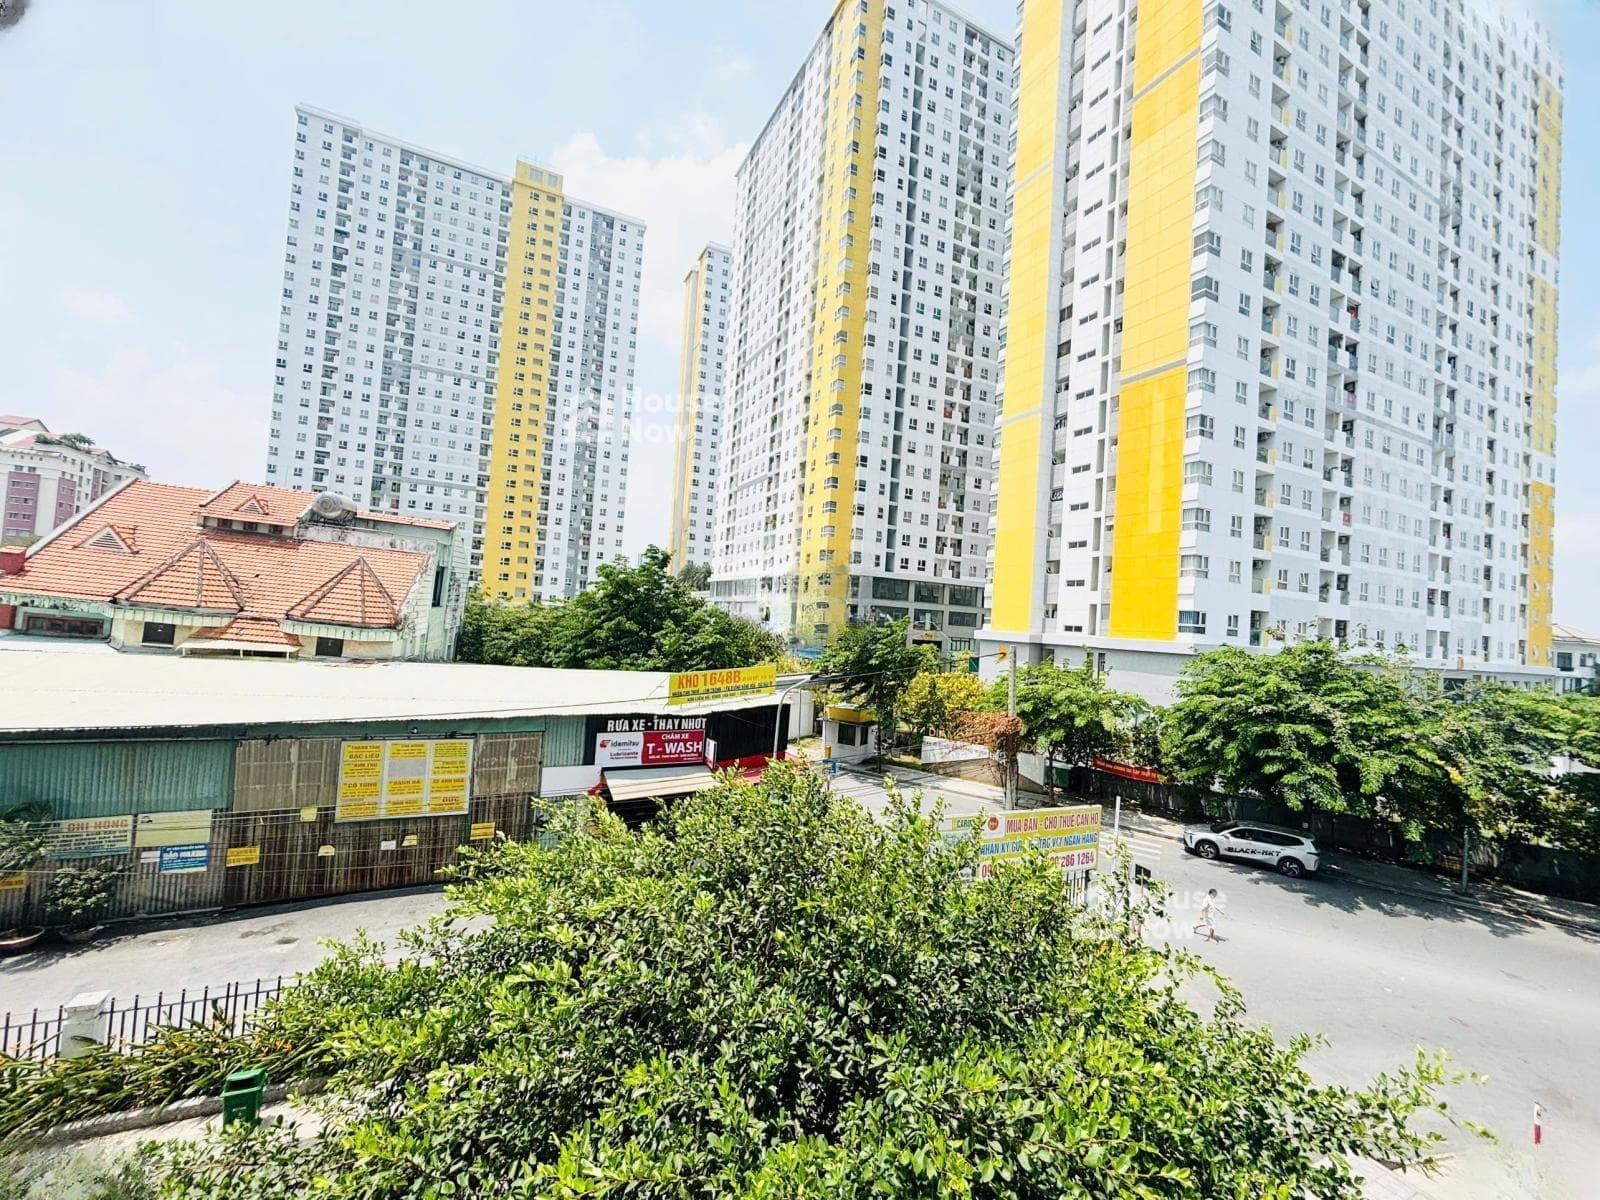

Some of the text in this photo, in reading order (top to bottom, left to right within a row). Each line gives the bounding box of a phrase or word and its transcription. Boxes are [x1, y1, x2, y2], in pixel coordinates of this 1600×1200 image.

[677, 673, 699, 689] KHO
[702, 670, 741, 687] 1648B
[632, 719, 646, 731] XE
[653, 717, 680, 731] THAY
[646, 743, 656, 755] T
[664, 741, 703, 754] WASH
[1006, 818, 1022, 833] MUA
[1044, 815, 1058, 830] CHO
[1060, 853, 1075, 867] 286
[1077, 851, 1094, 866] 1264
